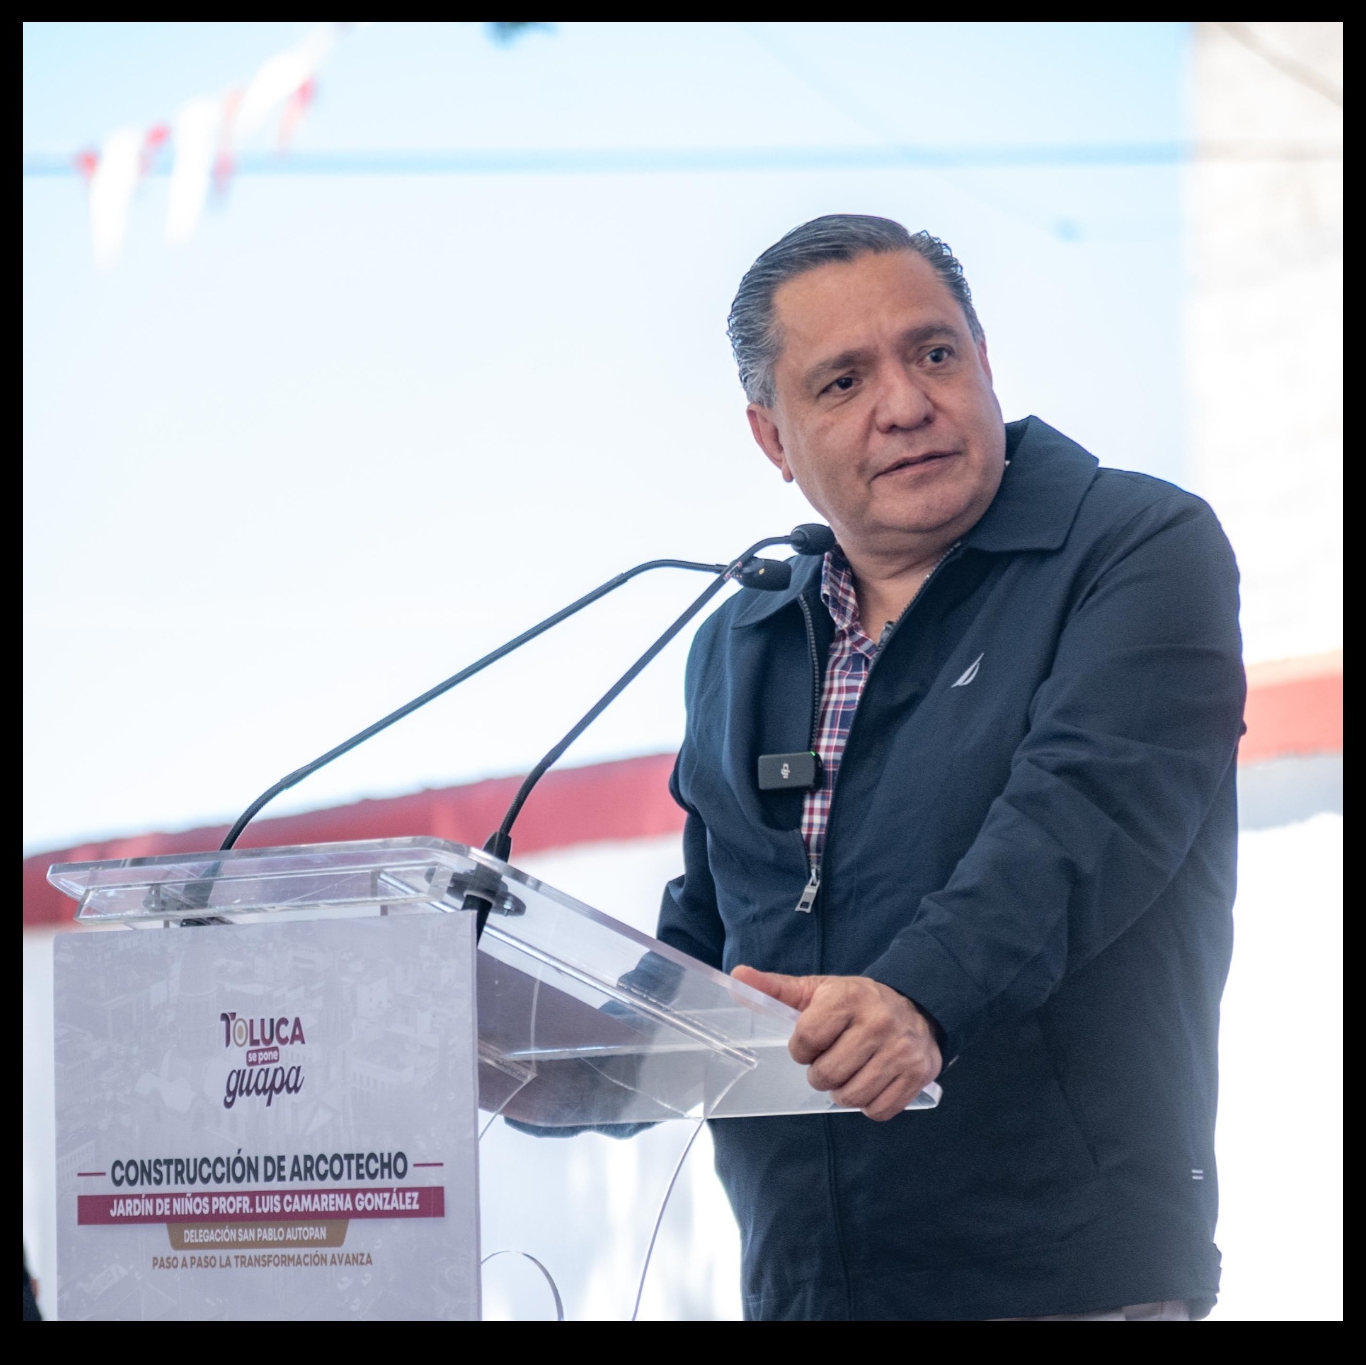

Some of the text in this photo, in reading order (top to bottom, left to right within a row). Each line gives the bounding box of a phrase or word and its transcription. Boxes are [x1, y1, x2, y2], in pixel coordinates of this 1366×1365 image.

[220, 1012, 306, 1049] TOLUCA
[248, 1050, 279, 1065] se pone
[223, 1065, 305, 1109] guapa
[111, 1148, 408, 1187] CONSTRUCCIÓN DE ARCOTECHO
[110, 1188, 420, 1217] JARDÍN DE NIÑOS PROFR. LUIS CAMARENA GONZÁLEZ
[184, 1226, 327, 1243] DELEGACIÓN SAN PABLO AUTOPAN
[152, 1250, 373, 1270] PASO A PASO LA TRANSFORMACIÓN AVANZA
